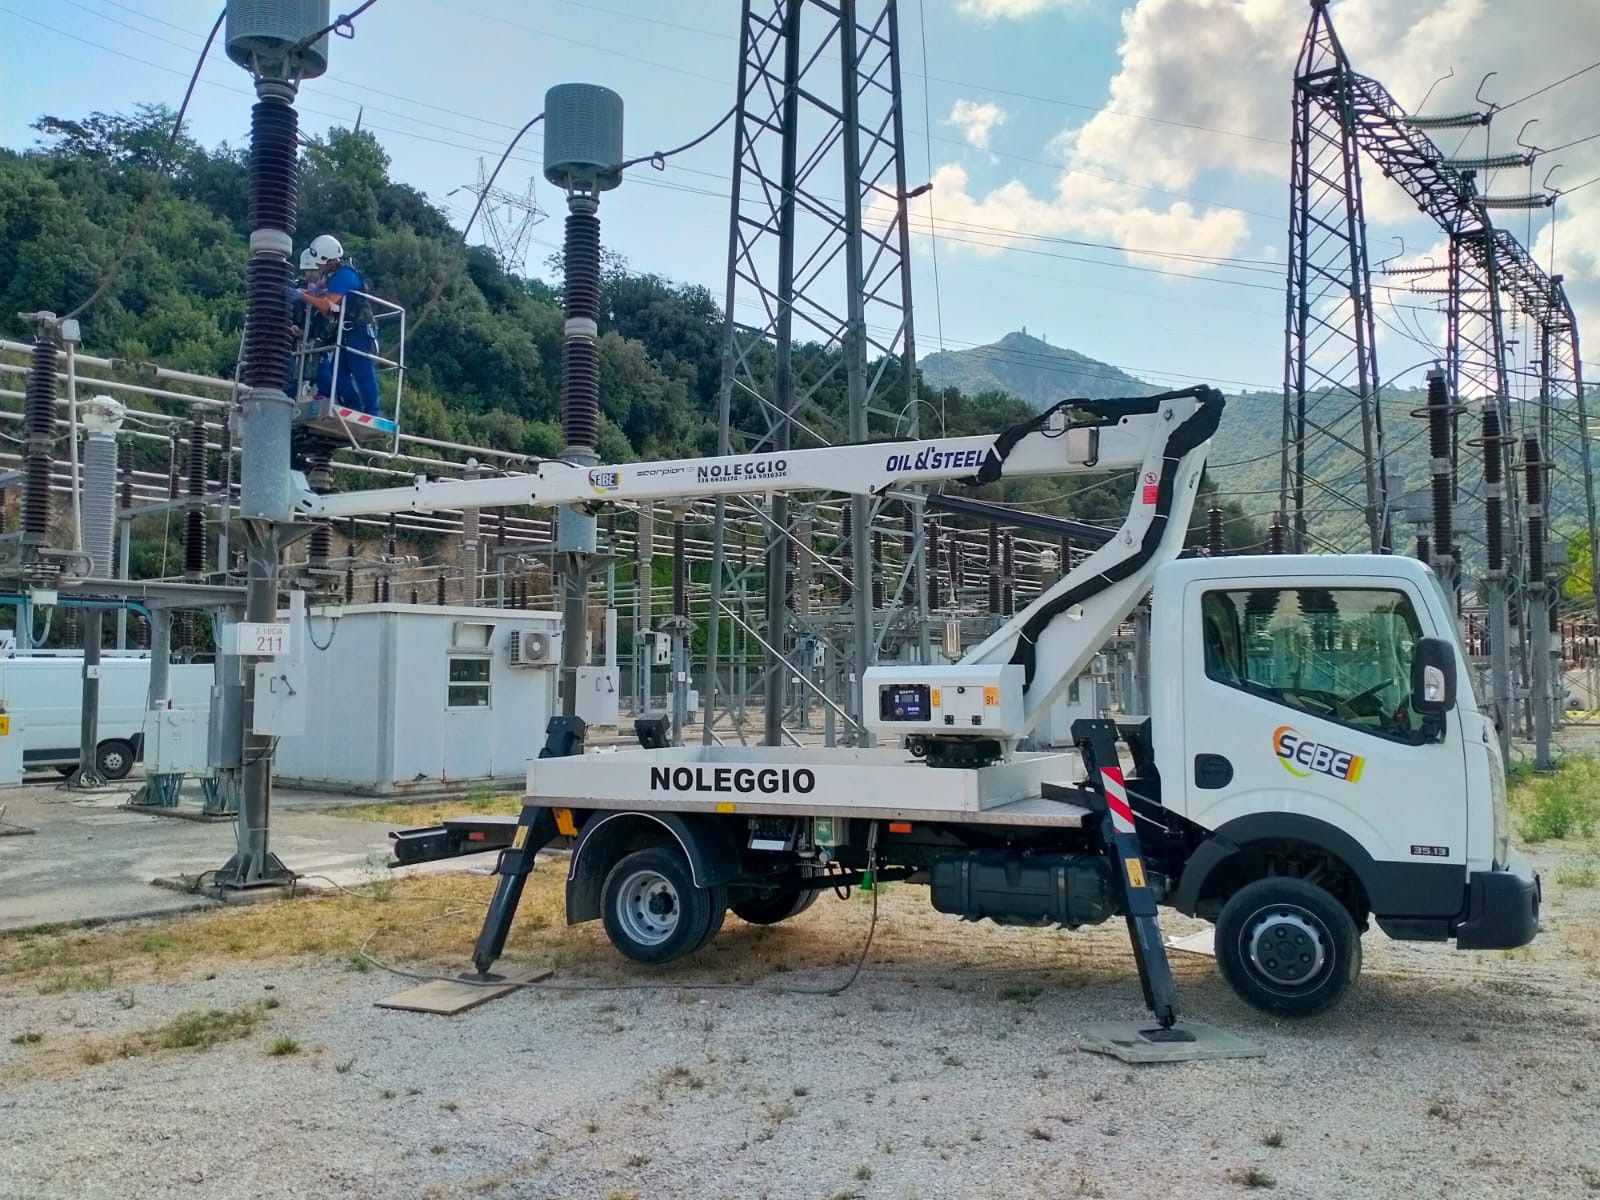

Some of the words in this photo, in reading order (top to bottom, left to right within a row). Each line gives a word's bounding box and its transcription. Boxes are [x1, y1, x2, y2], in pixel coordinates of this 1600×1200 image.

[698, 460, 787, 478] NOLEGGIO
[589, 470, 618, 487] SEBE
[257, 636, 282, 652] 211
[1276, 734, 1353, 780] SEBE
[651, 767, 816, 793] NOLEGGIO
[1412, 846, 1447, 856] 35.13
